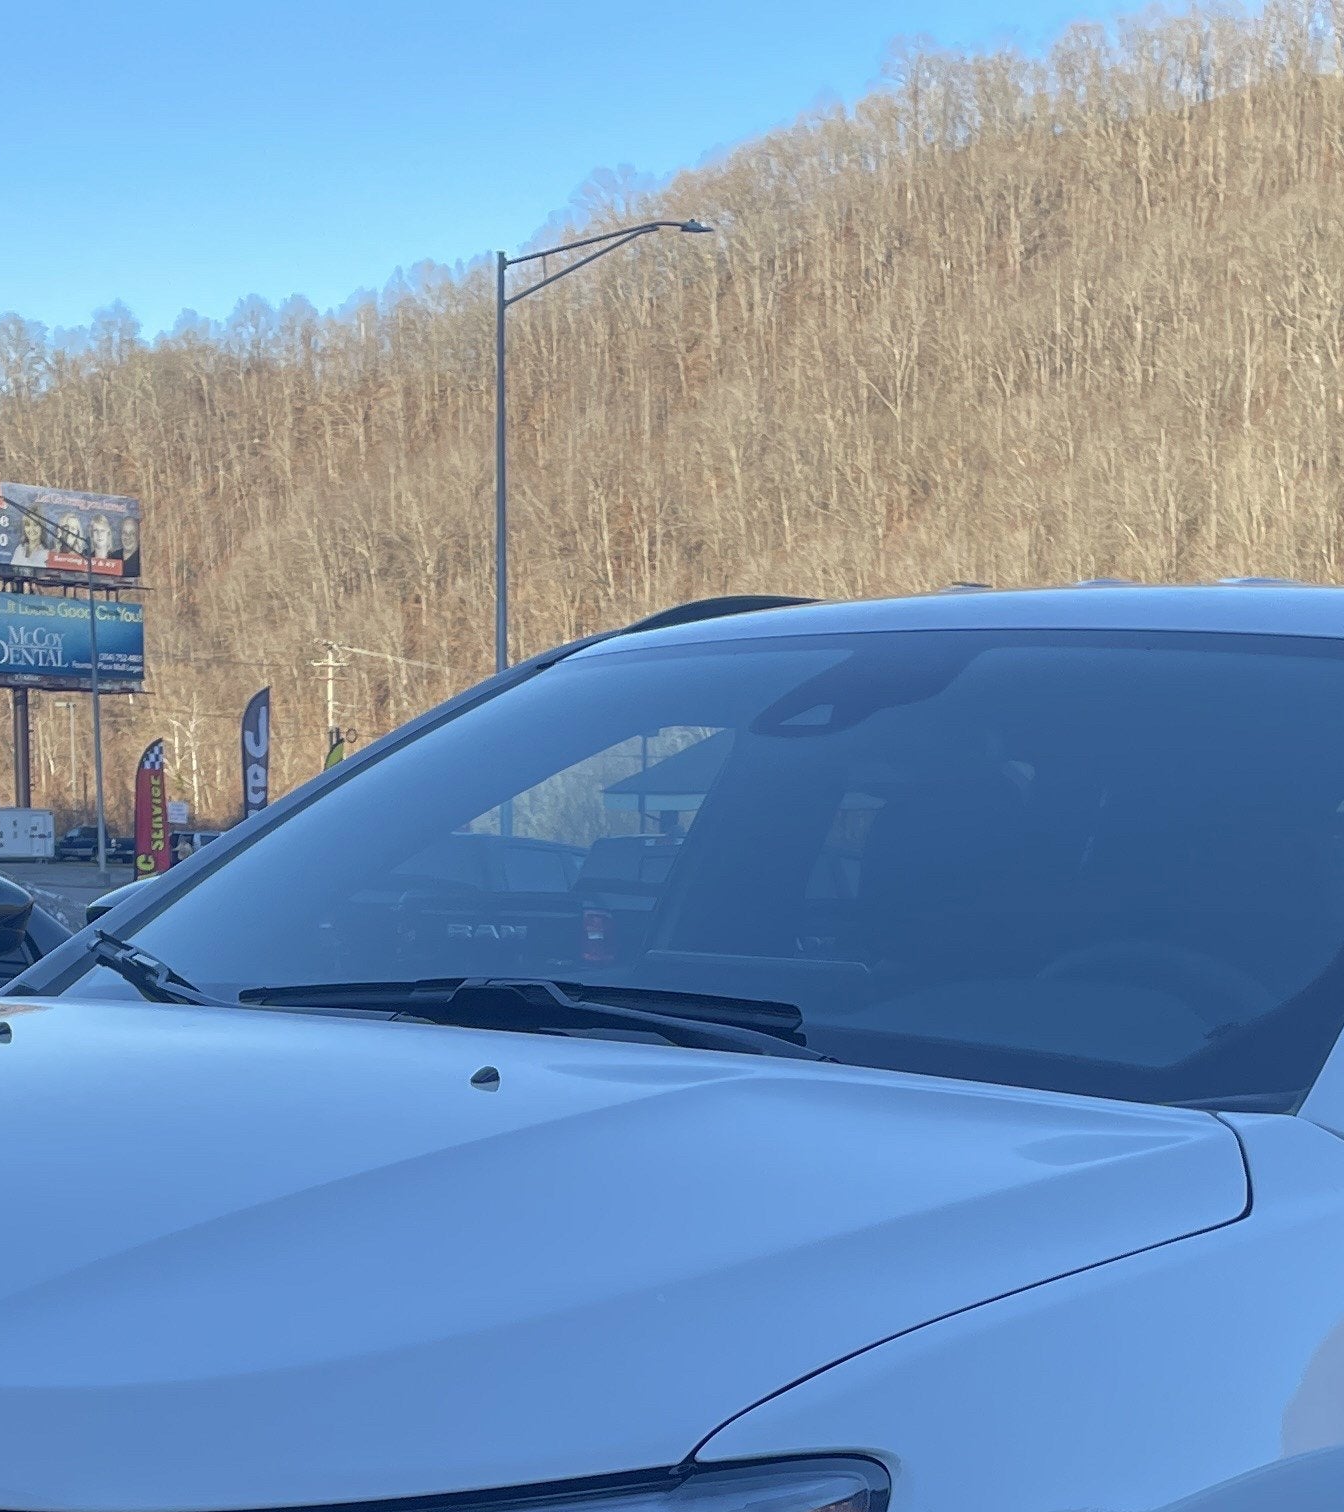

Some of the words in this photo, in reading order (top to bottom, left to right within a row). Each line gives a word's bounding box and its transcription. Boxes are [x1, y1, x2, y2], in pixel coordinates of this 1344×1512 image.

[117, 606, 143, 623] You!
[244, 706, 268, 817] Je
[150, 775, 165, 851] SERVICE
